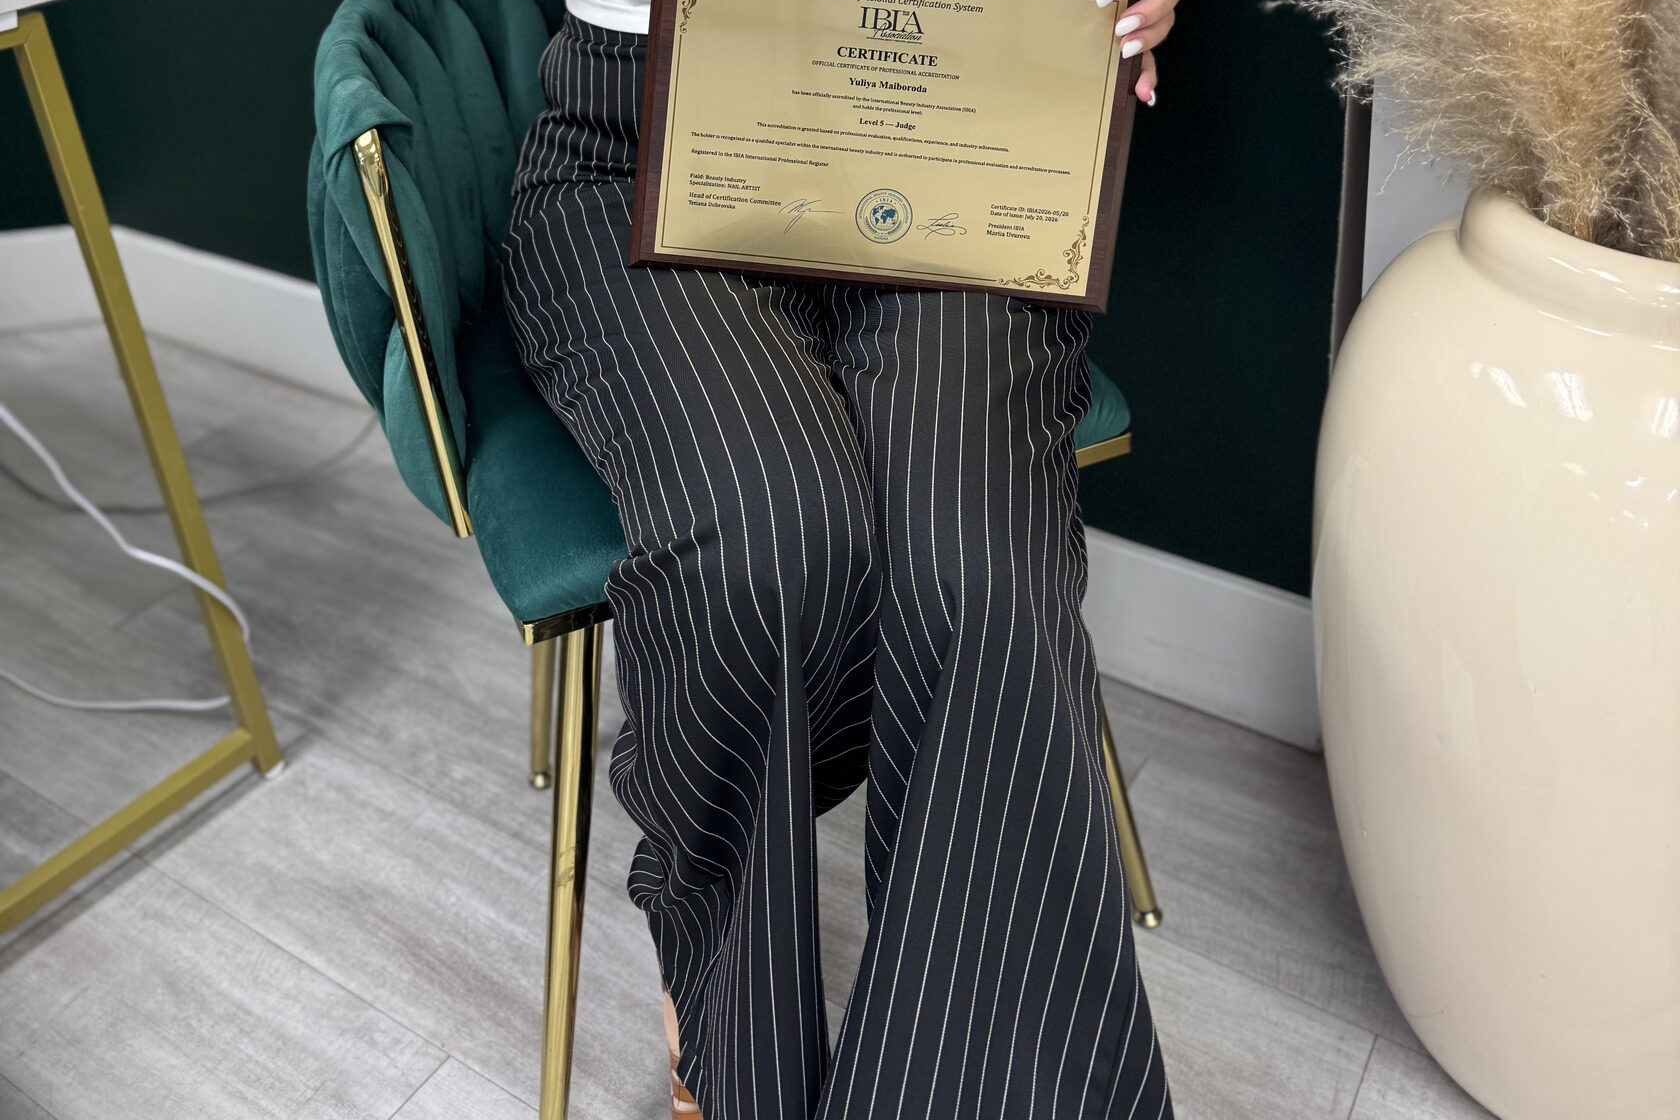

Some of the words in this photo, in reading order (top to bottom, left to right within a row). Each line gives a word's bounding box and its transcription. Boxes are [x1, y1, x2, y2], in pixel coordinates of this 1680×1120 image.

[952, 2, 983, 13] System
[858, 6, 925, 34] IBIA
[872, 20, 922, 41] Association
[836, 46, 937, 67] CERTIFICATE
[849, 77, 876, 89] Yuliya
[878, 80, 927, 93] Maiboroda
[859, 117, 878, 126] Level
[894, 121, 916, 131] Judge
[712, 193, 748, 203] Certification
[749, 197, 782, 206] Committee
[1006, 231, 1030, 239] Uvarova
